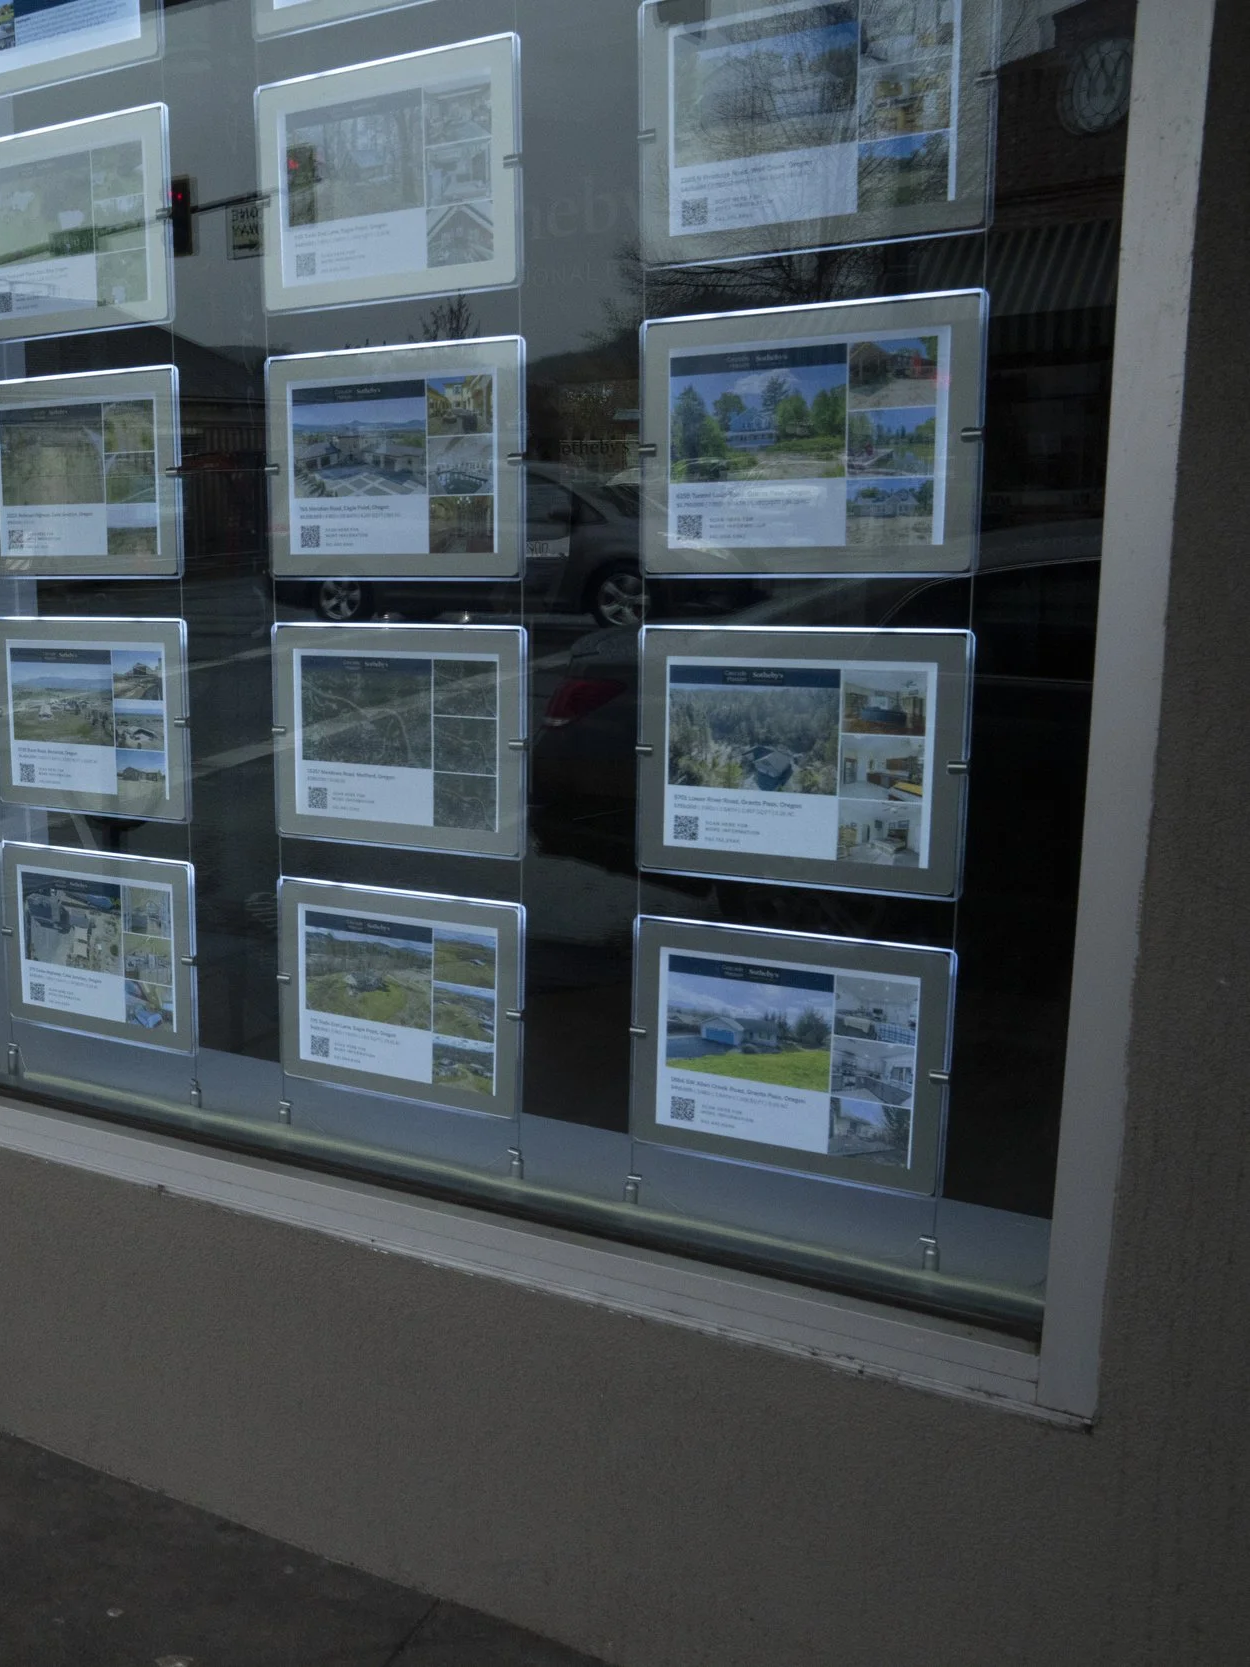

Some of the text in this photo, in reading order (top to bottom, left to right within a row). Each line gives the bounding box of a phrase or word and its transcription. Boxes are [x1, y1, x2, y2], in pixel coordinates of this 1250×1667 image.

[752, 671, 784, 680] Sotheby's
[779, 801, 802, 809] Oregon
[746, 1088, 766, 1097] Grants
[783, 1095, 806, 1105] Oregon
